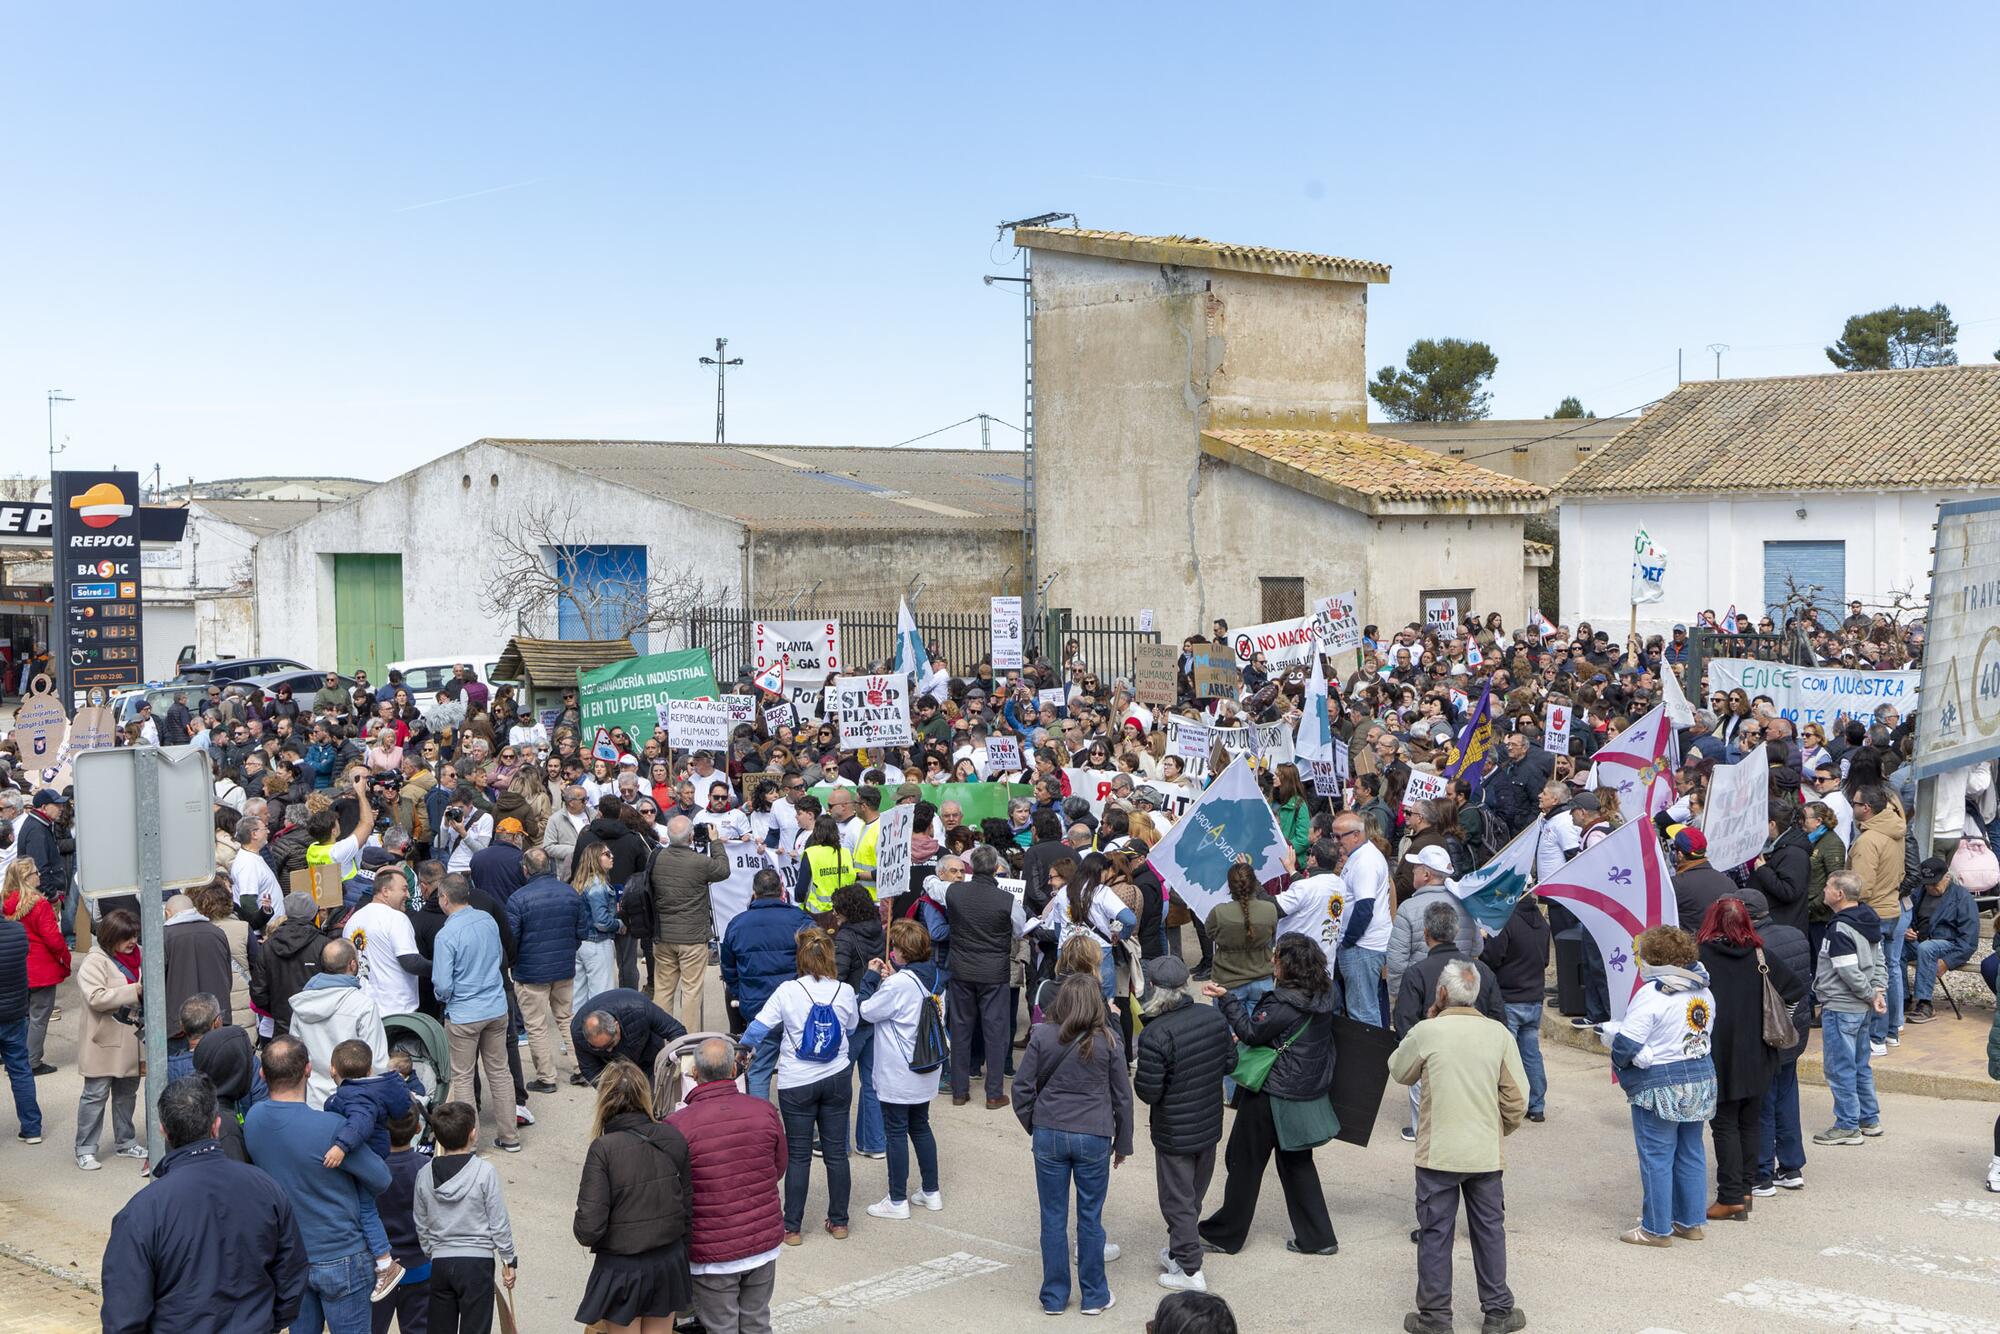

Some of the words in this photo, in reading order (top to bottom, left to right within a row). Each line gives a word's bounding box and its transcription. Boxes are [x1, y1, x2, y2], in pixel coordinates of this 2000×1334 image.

[70, 535, 135, 547] REPSOL
[77, 560, 129, 578] BASIC
[776, 641, 813, 652] PLANTA
[1257, 633, 1276, 652] NO
[1139, 645, 1173, 658] REPOBLAR
[646, 665, 708, 685] INDUSTRIAL
[1139, 671, 1173, 681] HUMANOS
[1742, 666, 1798, 690] ENCE
[1801, 676, 1828, 692] CON
[1833, 676, 1904, 697] NUESTRA
[592, 701, 604, 717] EN
[605, 699, 619, 714] TU
[620, 691, 669, 713] PUEBLO
[707, 702, 727, 712] PAGE
[716, 716, 728, 725] CON
[732, 712, 747, 720] NO
[843, 707, 902, 722] PLANTA
[1780, 708, 1799, 723] NO
[1804, 708, 1825, 726] TE
[680, 727, 720, 737] HUMANOS
[1547, 732, 1566, 743] STOP
[670, 739, 679, 747] NO
[681, 738, 694, 747] CON
[1312, 762, 1332, 777] STOP
[745, 853, 760, 868] las
[880, 842, 908, 869] PLANTA
